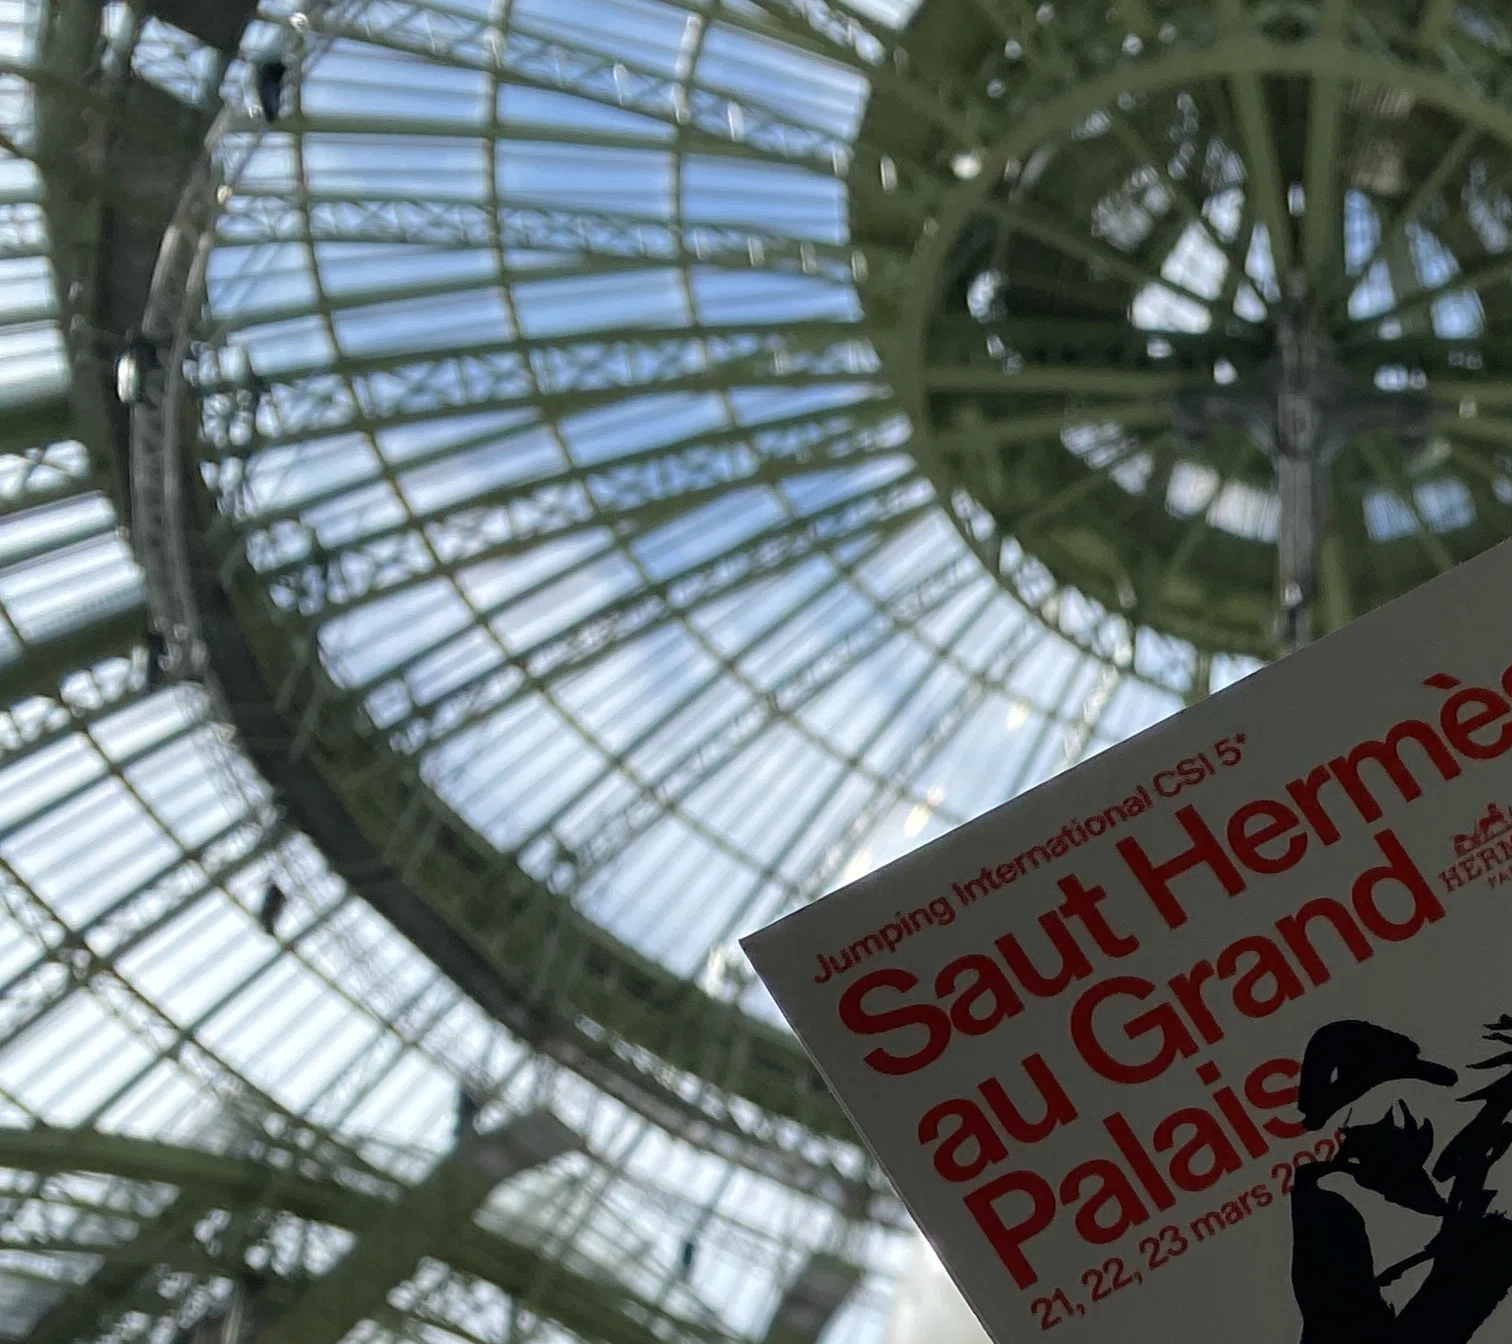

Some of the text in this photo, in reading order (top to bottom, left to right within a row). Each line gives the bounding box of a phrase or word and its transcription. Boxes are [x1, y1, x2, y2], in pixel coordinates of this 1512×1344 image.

[814, 897, 956, 984] Jumping
[952, 785, 1154, 907] International
[1152, 751, 1217, 799] CSI
[838, 873, 1140, 1076] Saut
[918, 828, 1446, 1183] au Grand
[963, 1057, 1306, 1290] Palais
[1030, 1287, 1087, 1332] 21,
[1081, 1256, 1144, 1303] 22,
[1138, 1223, 1190, 1270] 23
[1189, 1183, 1274, 1242] mars
